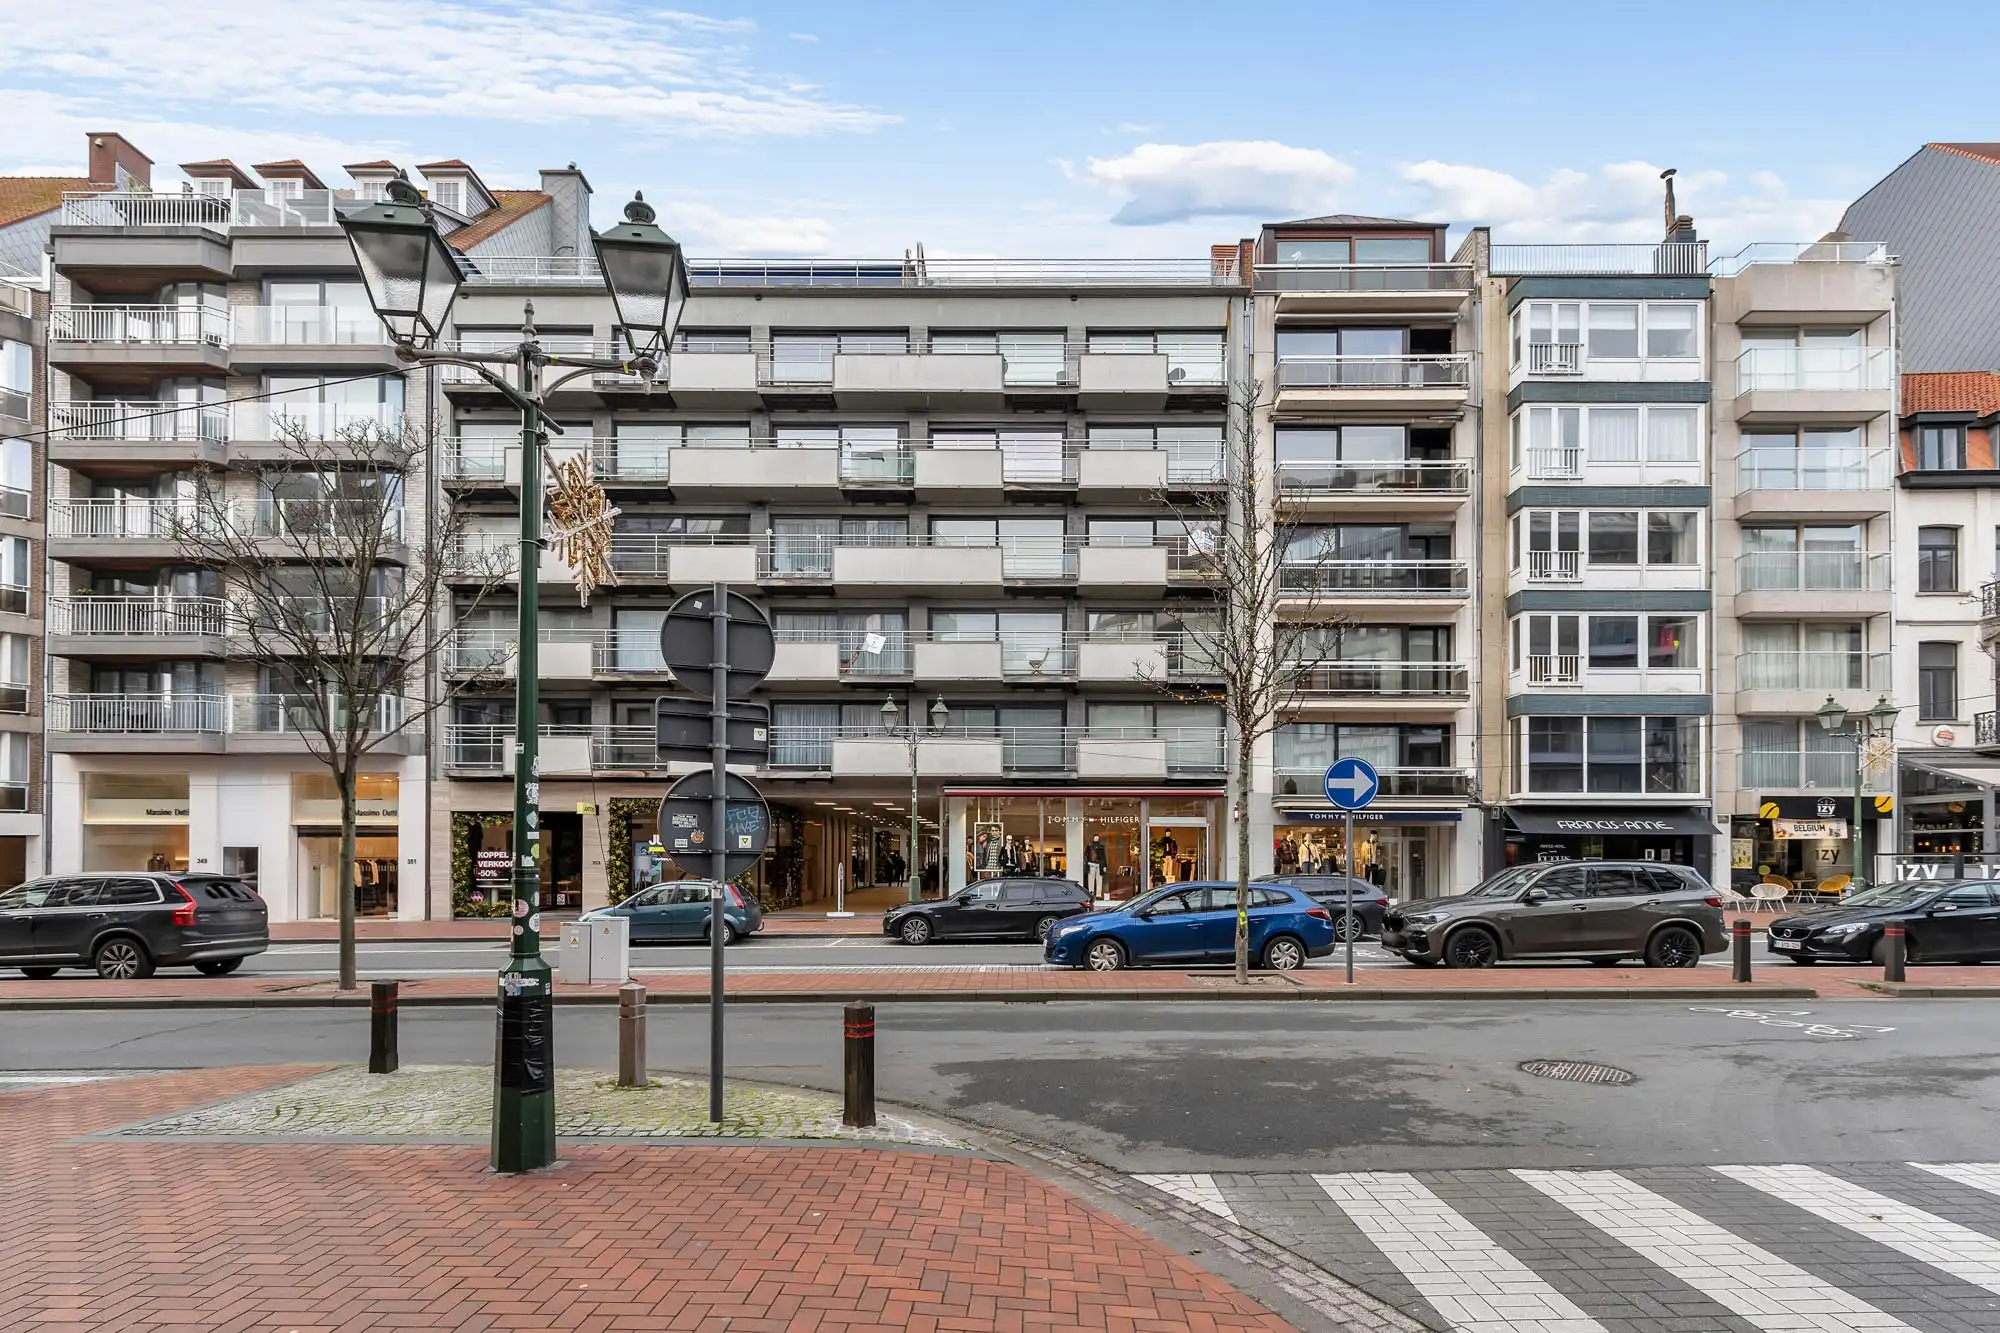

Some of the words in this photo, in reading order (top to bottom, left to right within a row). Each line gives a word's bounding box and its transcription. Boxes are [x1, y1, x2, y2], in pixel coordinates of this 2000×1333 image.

[146, 808, 172, 816] Massimo
[174, 808, 190, 816] Dutti
[1048, 816, 1086, 824] TOMMY
[1556, 820, 1674, 830] FRANCIS-ANNE
[1793, 824, 1826, 832] BELGIUM
[477, 851, 509, 859] KOPPEL
